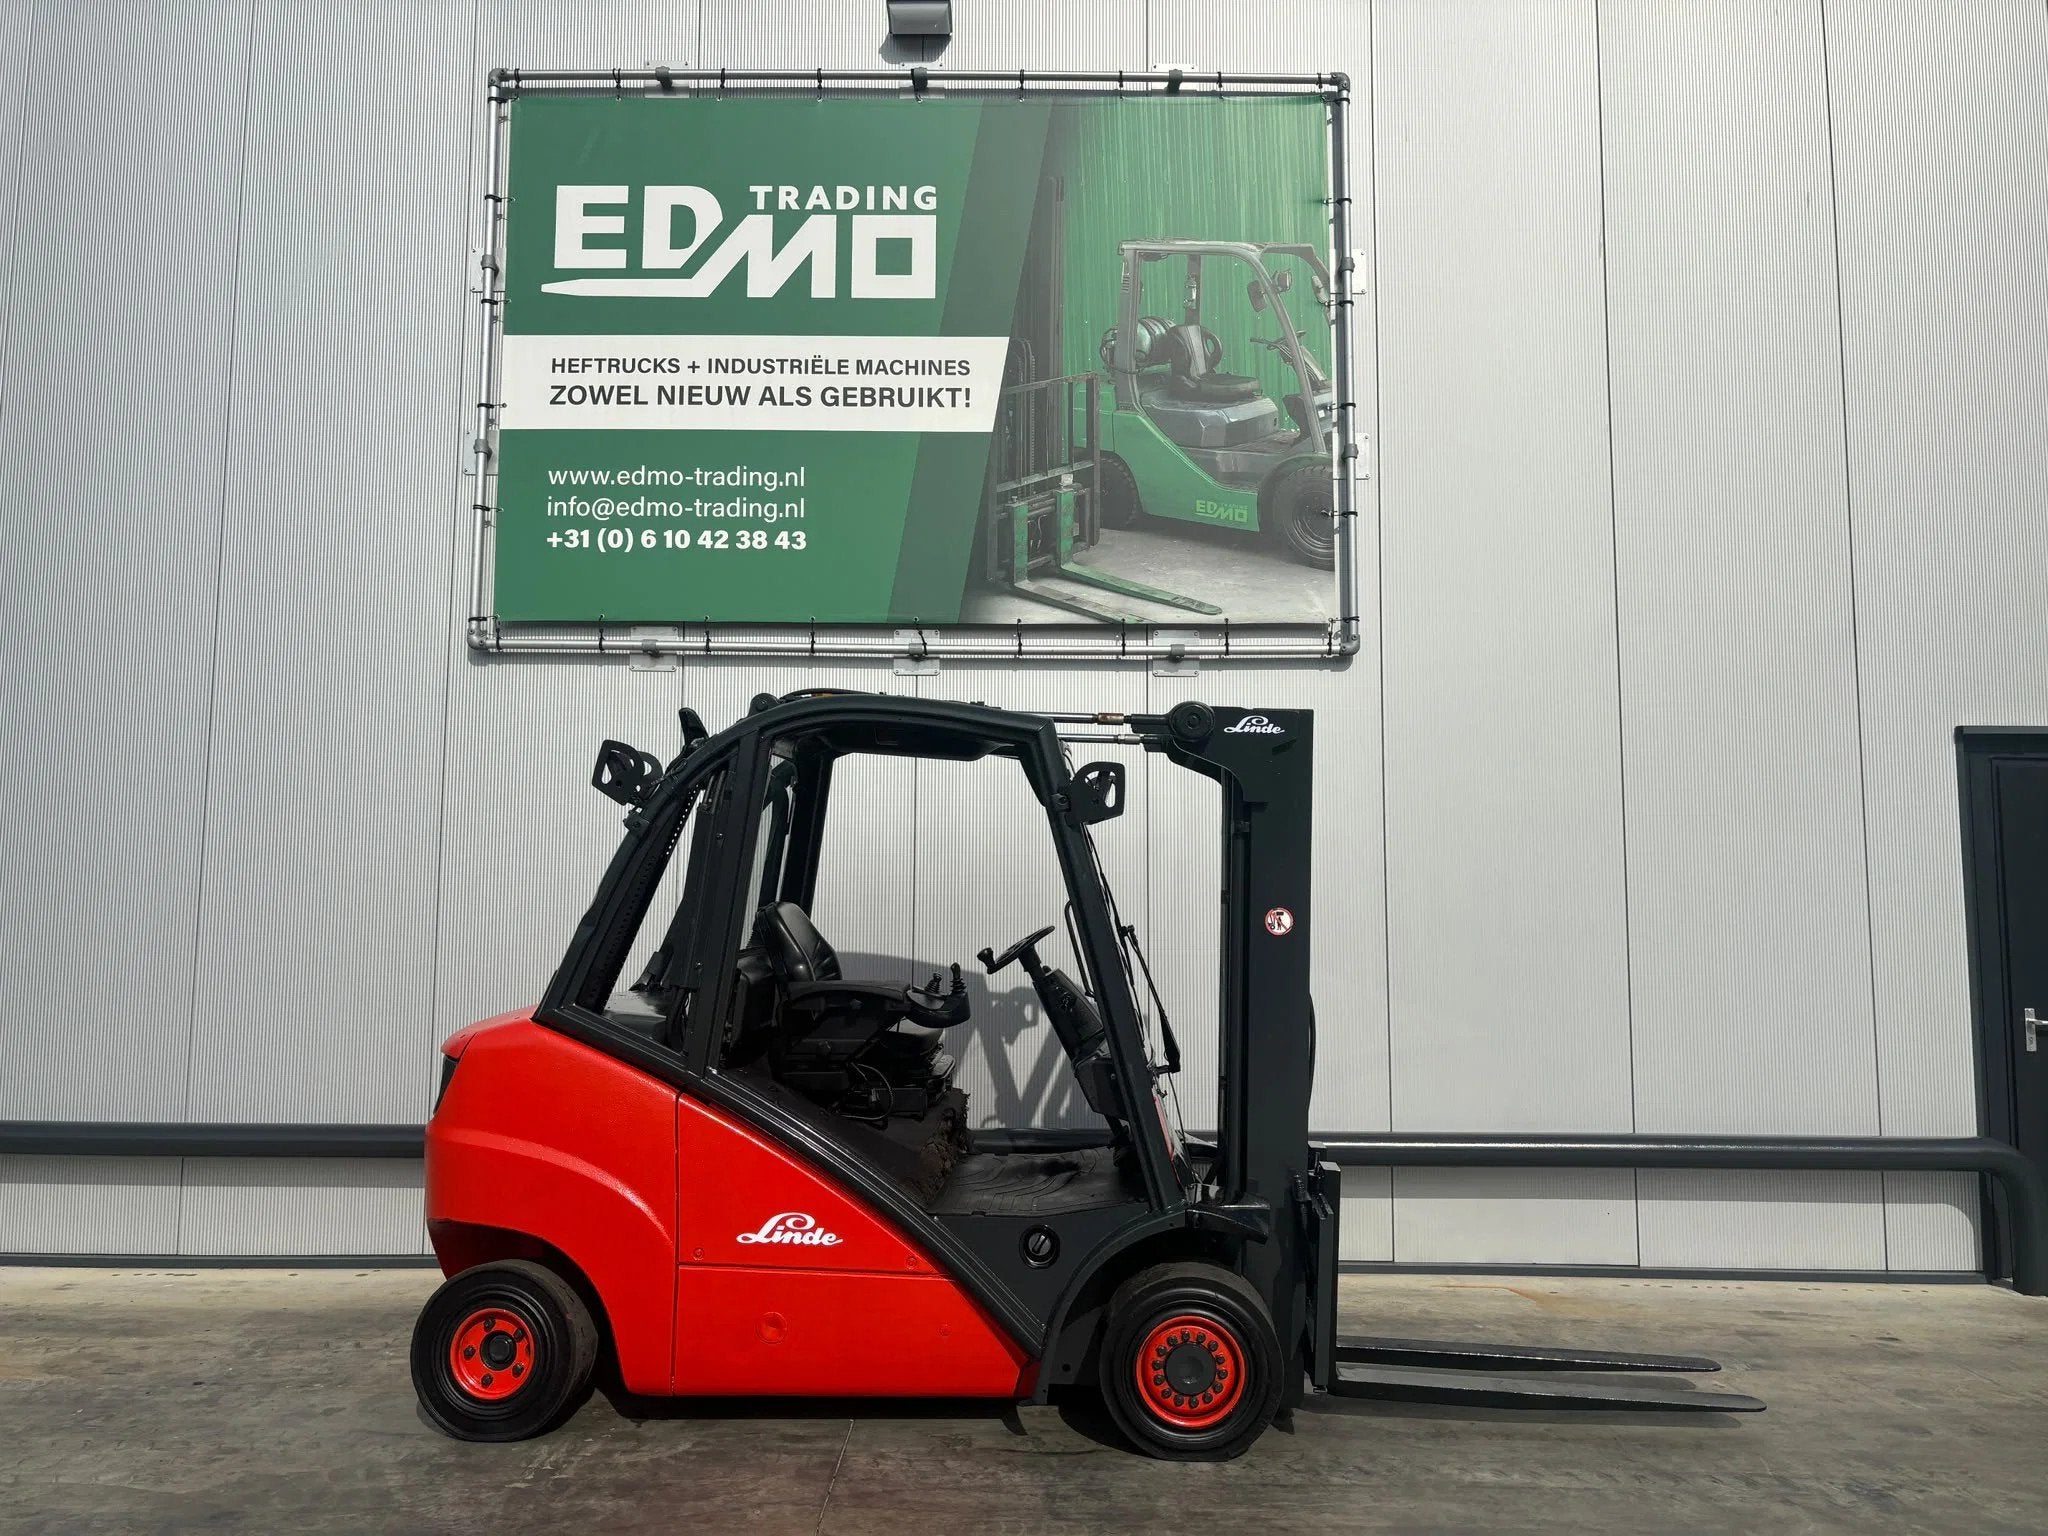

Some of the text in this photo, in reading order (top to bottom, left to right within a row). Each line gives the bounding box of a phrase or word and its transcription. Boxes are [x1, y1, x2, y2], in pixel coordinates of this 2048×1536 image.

[750, 185, 937, 211] TRADING
[541, 184, 937, 299] EDMO
[551, 354, 971, 376] HEFTRUCKS + INDUSTRIËLE MACHINES
[549, 384, 972, 409] ZOWEL NIEUW ALS GEBRUIKT!
[548, 465, 805, 492] www.edmo-trading.nl
[547, 496, 805, 523] info@edmo-trading.nl
[1194, 500, 1248, 523] EDMO
[547, 527, 807, 552] +31 (0) 6 10 42 38 43
[1223, 715, 1286, 735] Linde
[736, 1211, 844, 1247] Linde
